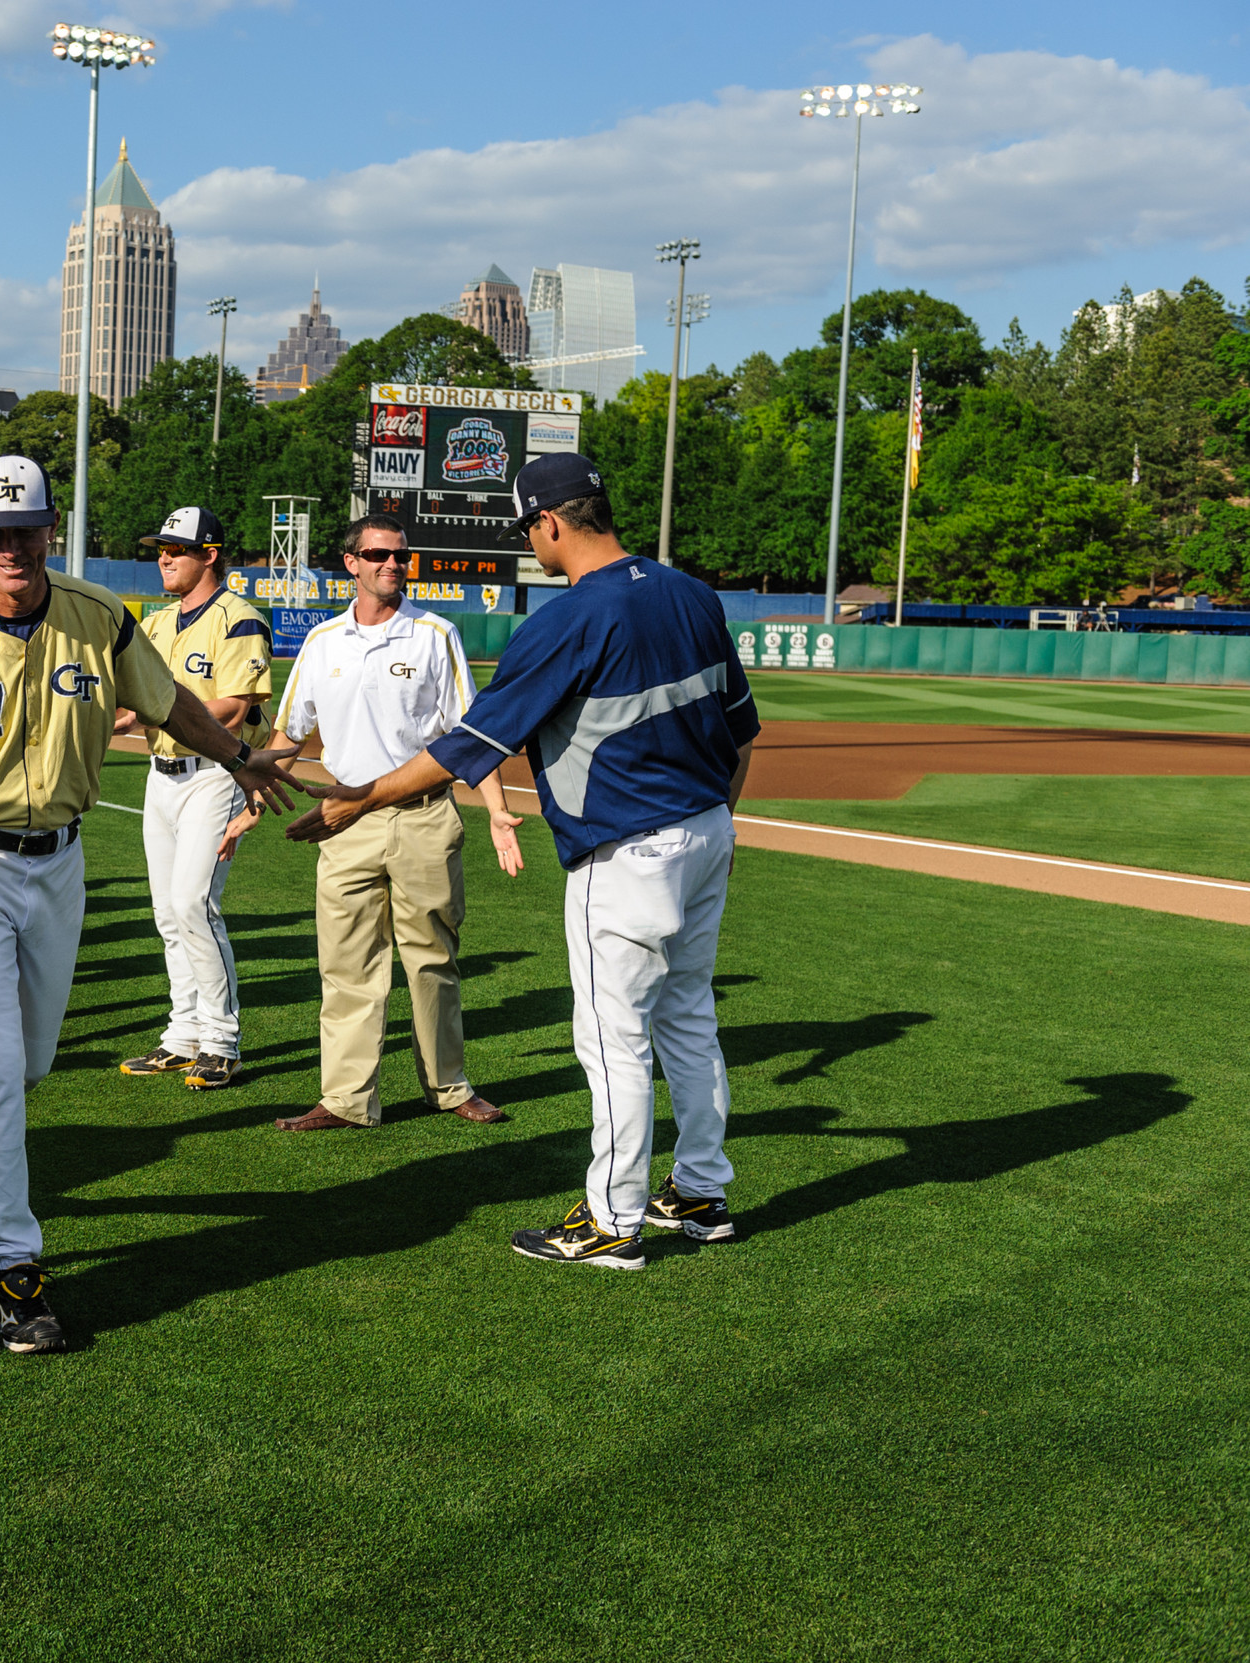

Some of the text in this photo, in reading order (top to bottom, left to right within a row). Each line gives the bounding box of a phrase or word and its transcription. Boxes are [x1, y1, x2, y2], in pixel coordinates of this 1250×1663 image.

[406, 386, 497, 408] GEORGIA
[502, 391, 556, 411] TECH
[374, 410, 423, 437] Coca-Cola
[374, 451, 420, 474] NAVY
[373, 474, 417, 483] navy.com
[378, 490, 405, 499] AT BAT
[427, 492, 444, 500] BALL
[466, 494, 488, 503] STRIKE
[382, 499, 400, 513] 32
[433, 560, 496, 573] 5:47 PM
[227, 571, 249, 596] GT
[326, 579, 358, 600] TEC
[405, 582, 465, 601] TBALL
[281, 611, 328, 626] EMORY
[741, 636, 753, 645] 27
[770, 636, 777, 645] 5
[793, 637, 805, 646] 23
[184, 652, 214, 680] GT
[390, 663, 416, 679] GT
[51, 662, 100, 702] GT
